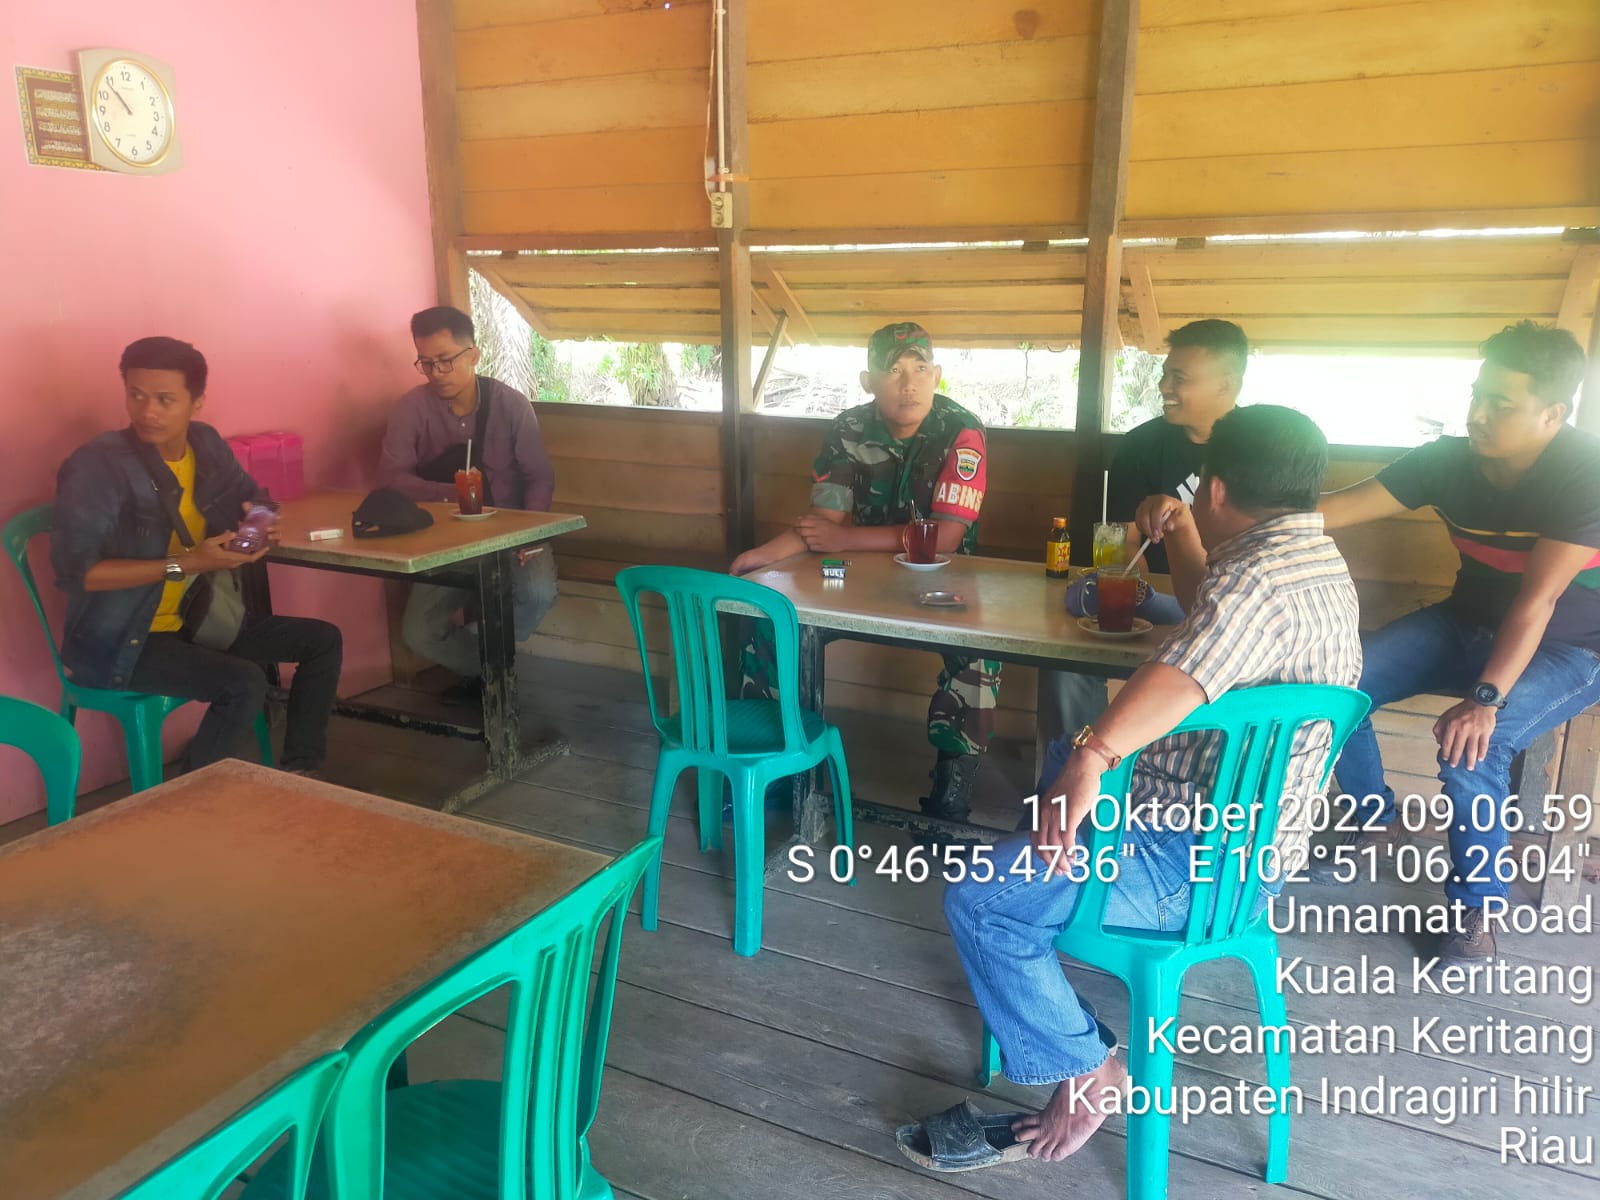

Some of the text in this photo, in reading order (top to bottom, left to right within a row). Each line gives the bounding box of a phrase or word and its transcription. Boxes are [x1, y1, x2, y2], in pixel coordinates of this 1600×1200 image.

[120, 71, 131, 81] 12
[140, 80, 145, 91] 1
[98, 90, 109, 101] 10
[149, 96, 155, 106] 2
[99, 105, 106, 116] 9
[153, 111, 160, 122] 3
[104, 121, 111, 133] 8
[151, 126, 158, 136] 4
[115, 137, 121, 148] 7
[146, 139, 152, 150] 5
[131, 145, 138, 156] 6
[934, 482, 984, 513] ABINS
